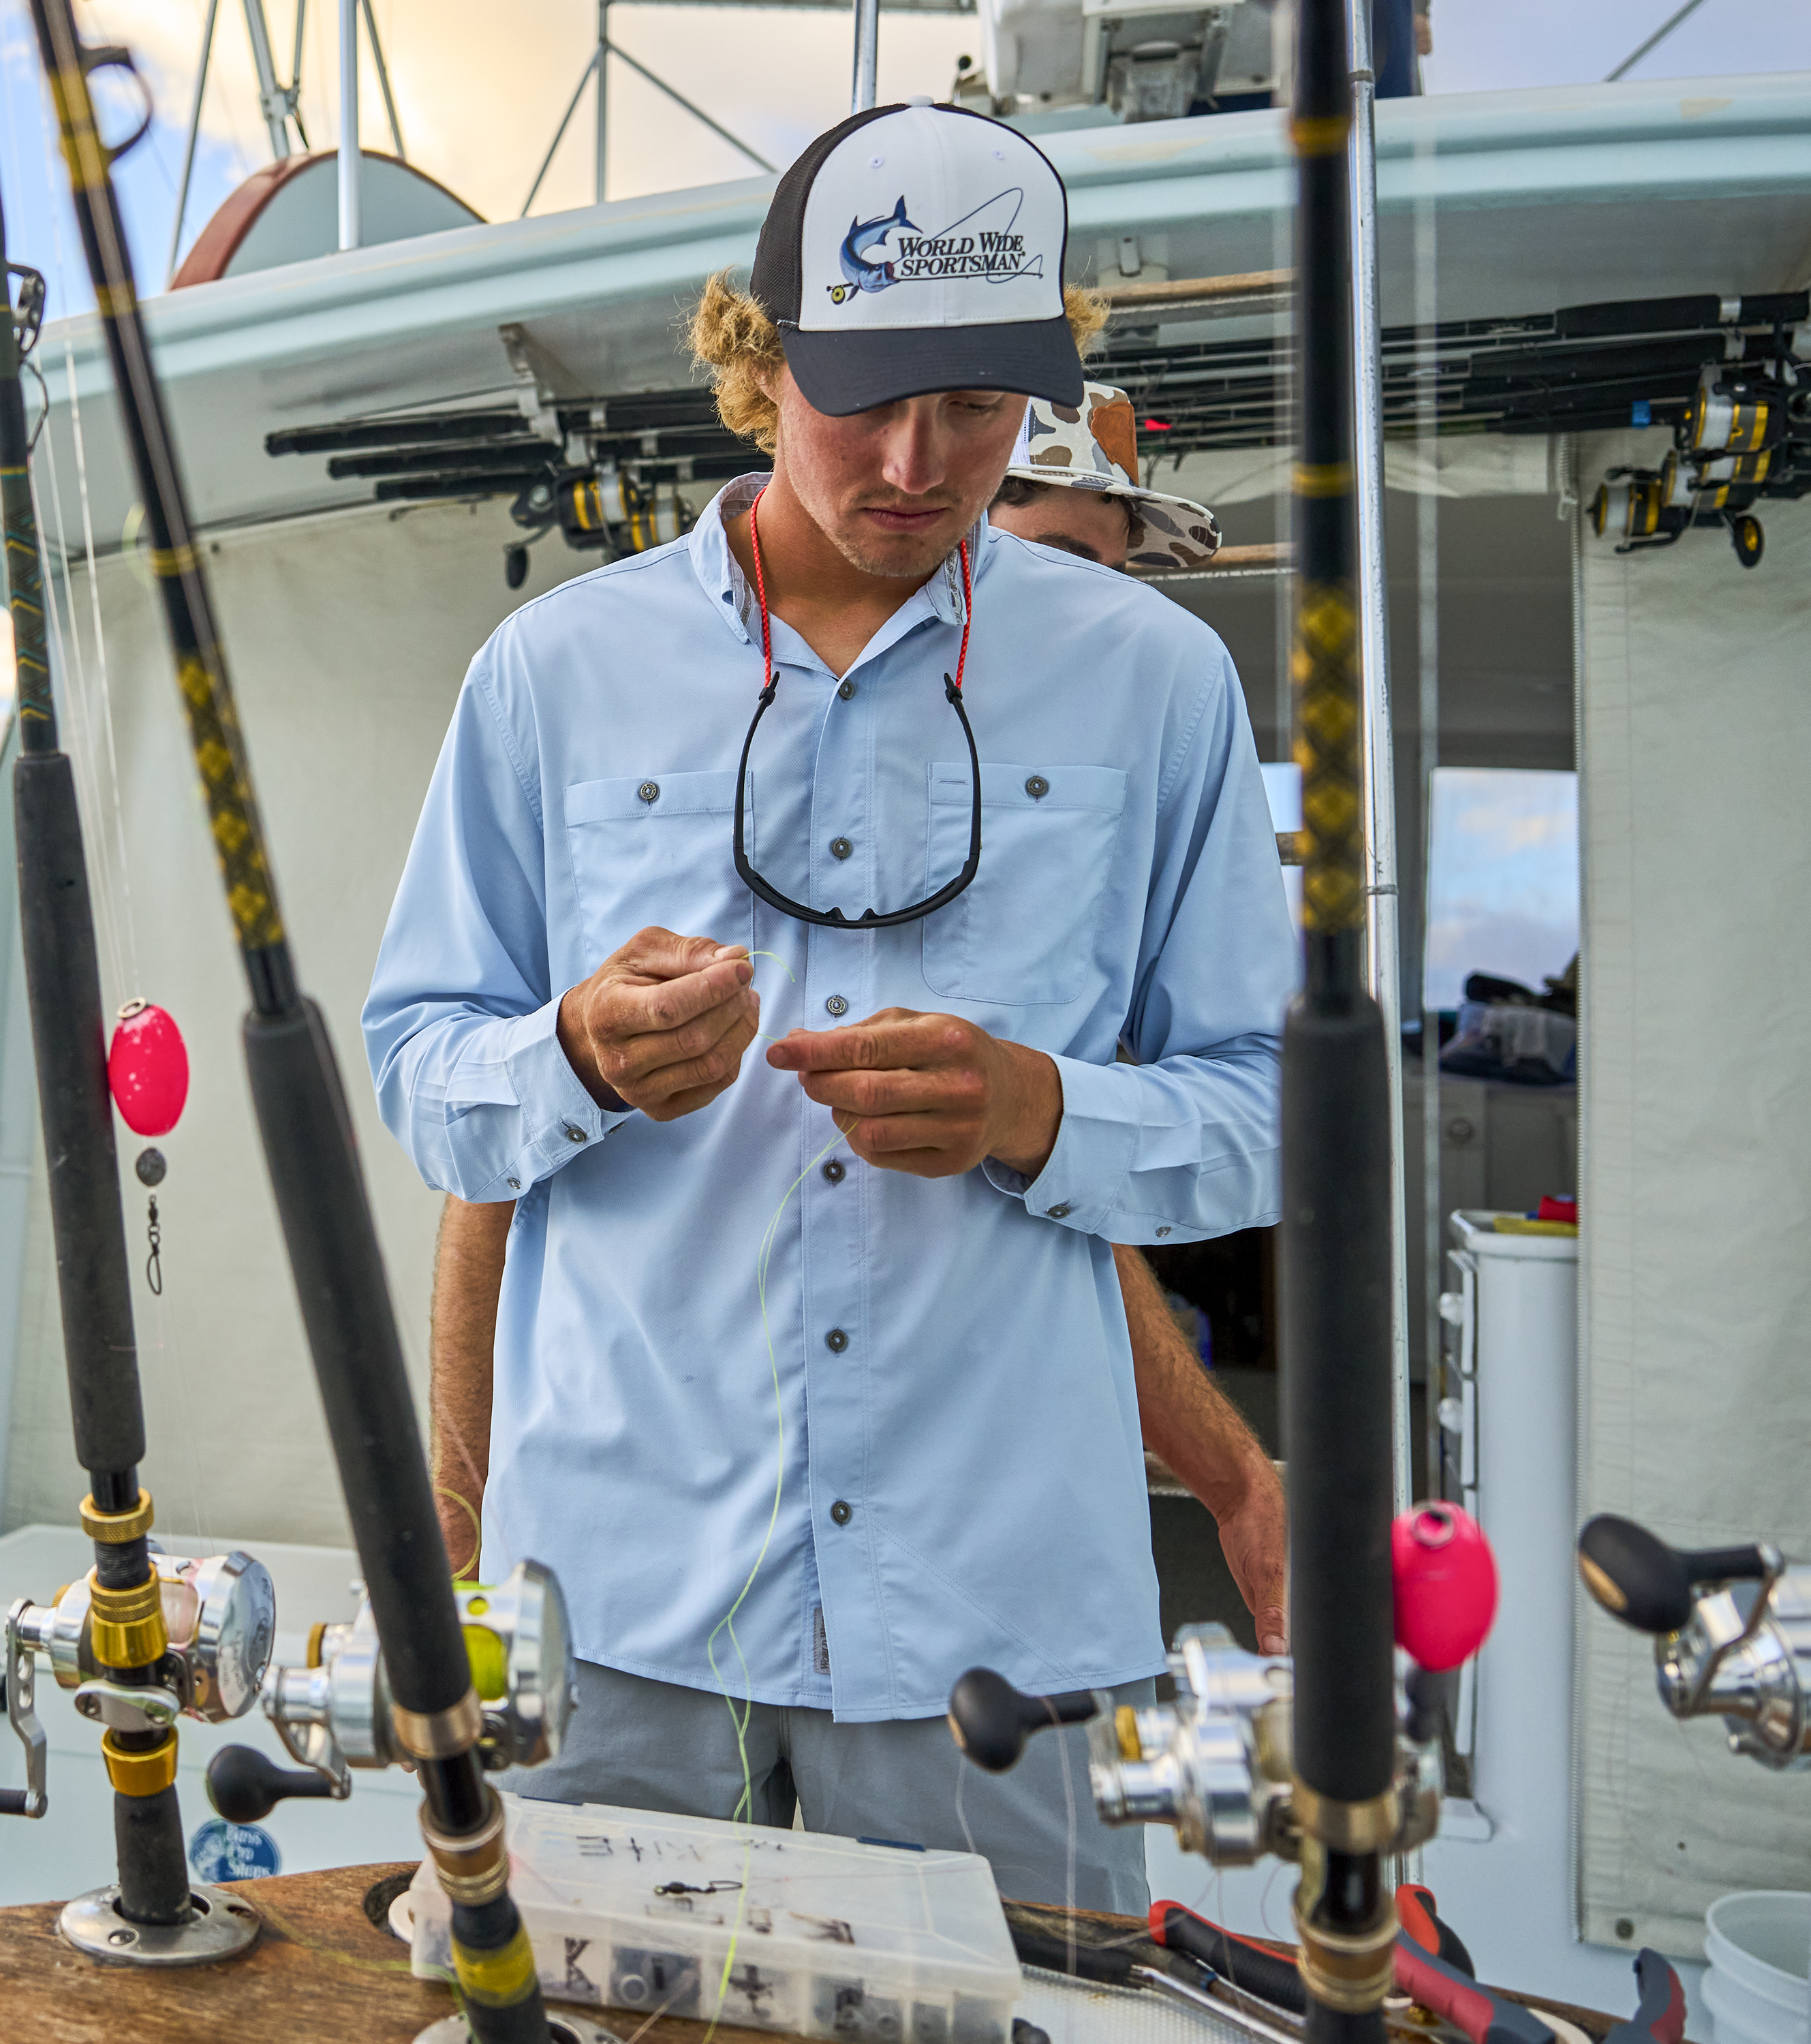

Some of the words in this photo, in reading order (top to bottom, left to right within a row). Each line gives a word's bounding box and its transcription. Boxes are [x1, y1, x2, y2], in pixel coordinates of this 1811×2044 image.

[898, 237, 974, 258] WORLD
[979, 232, 1023, 253] WIDE
[901, 253, 1021, 277] SPORTSMAN
